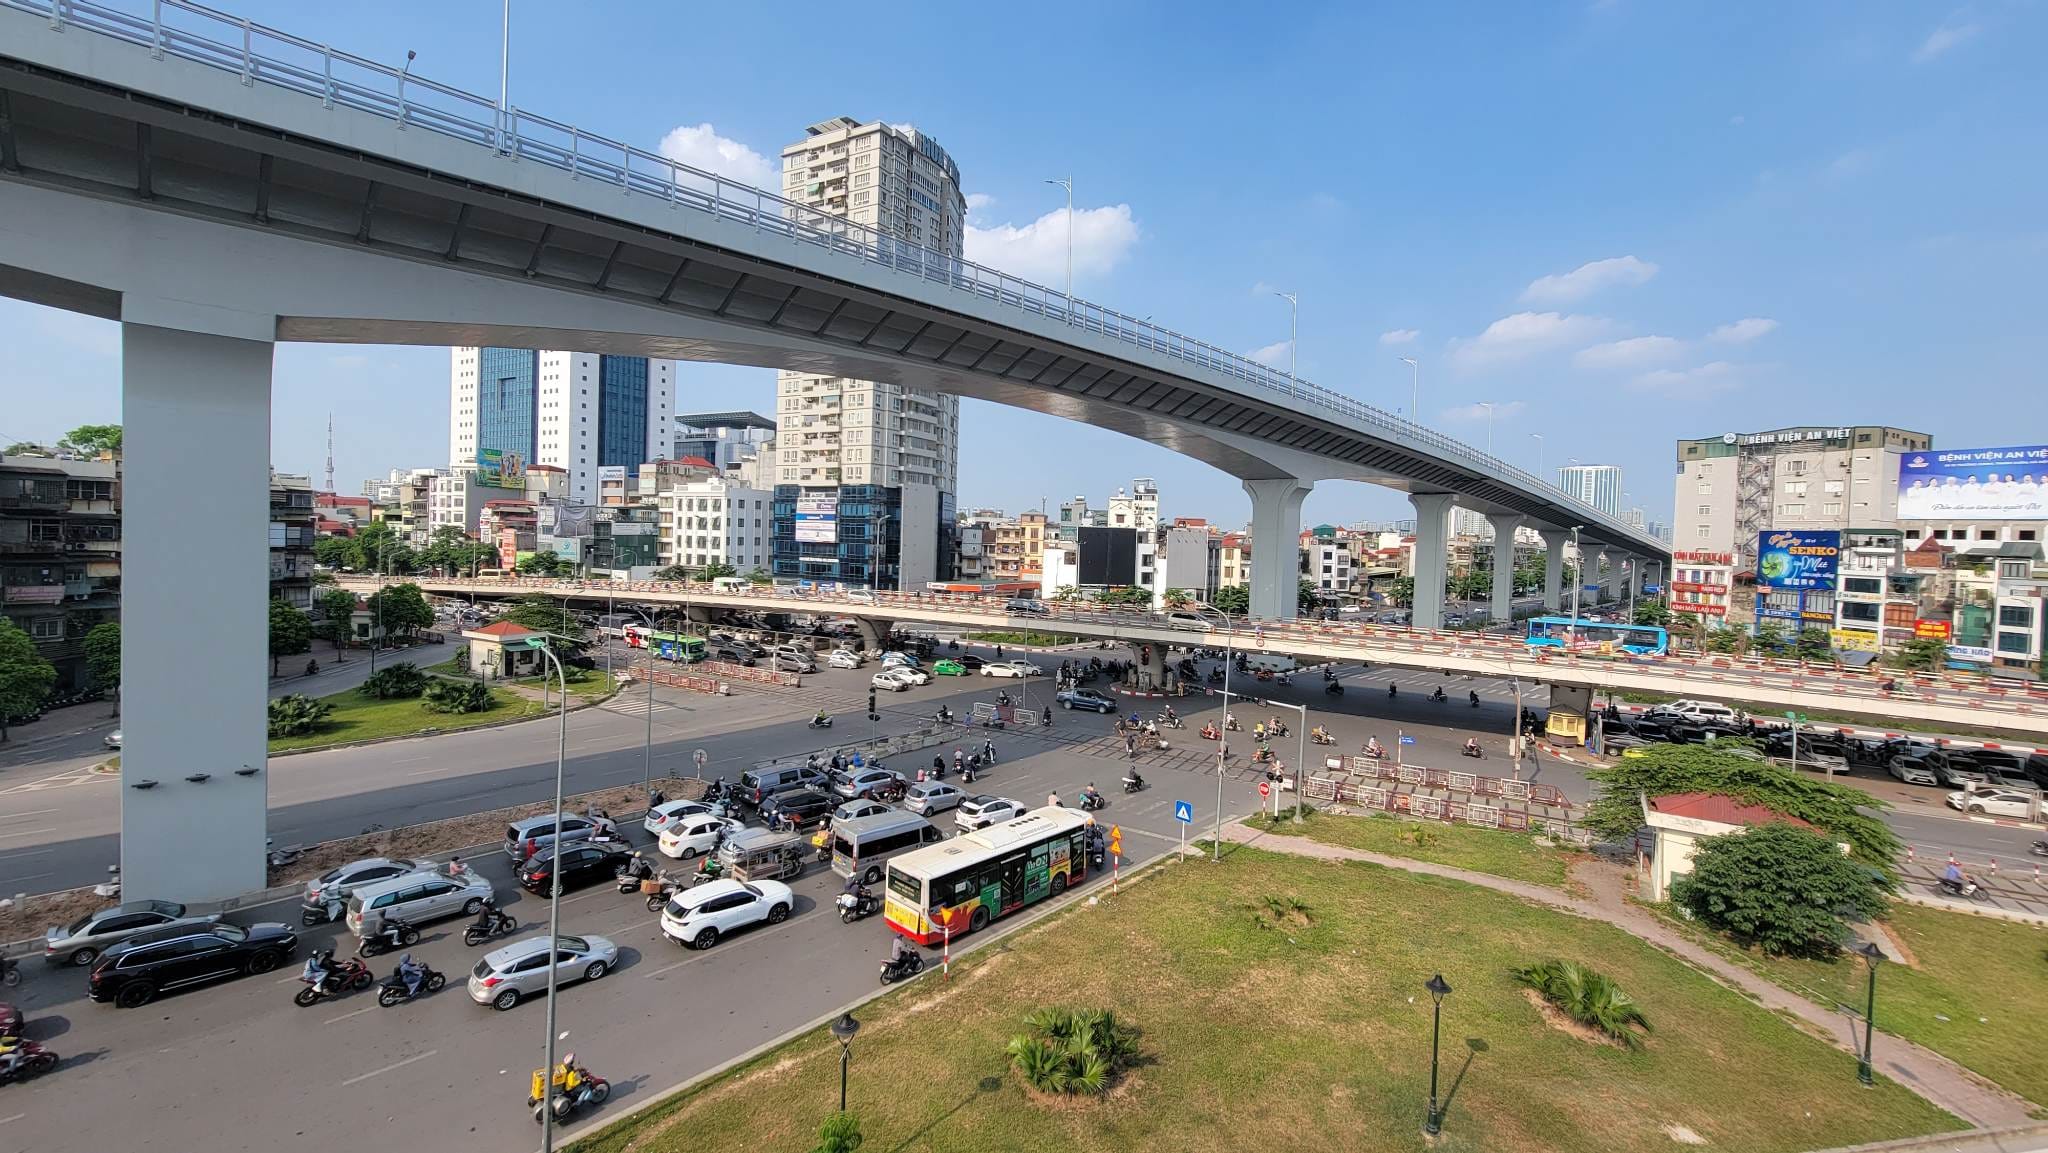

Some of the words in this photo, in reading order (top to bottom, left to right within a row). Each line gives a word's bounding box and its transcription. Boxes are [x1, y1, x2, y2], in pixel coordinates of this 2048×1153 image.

[1778, 432, 1802, 443] VIỆN
[1806, 430, 1822, 440] AN
[1826, 428, 1851, 439] VIỆT
[1938, 453, 1972, 462] BỆNH
[1974, 451, 2002, 460] VIỆN
[2006, 451, 2023, 459] AN
[2027, 449, 2048, 458] VIỆ
[1789, 546, 1838, 556] SENKO
